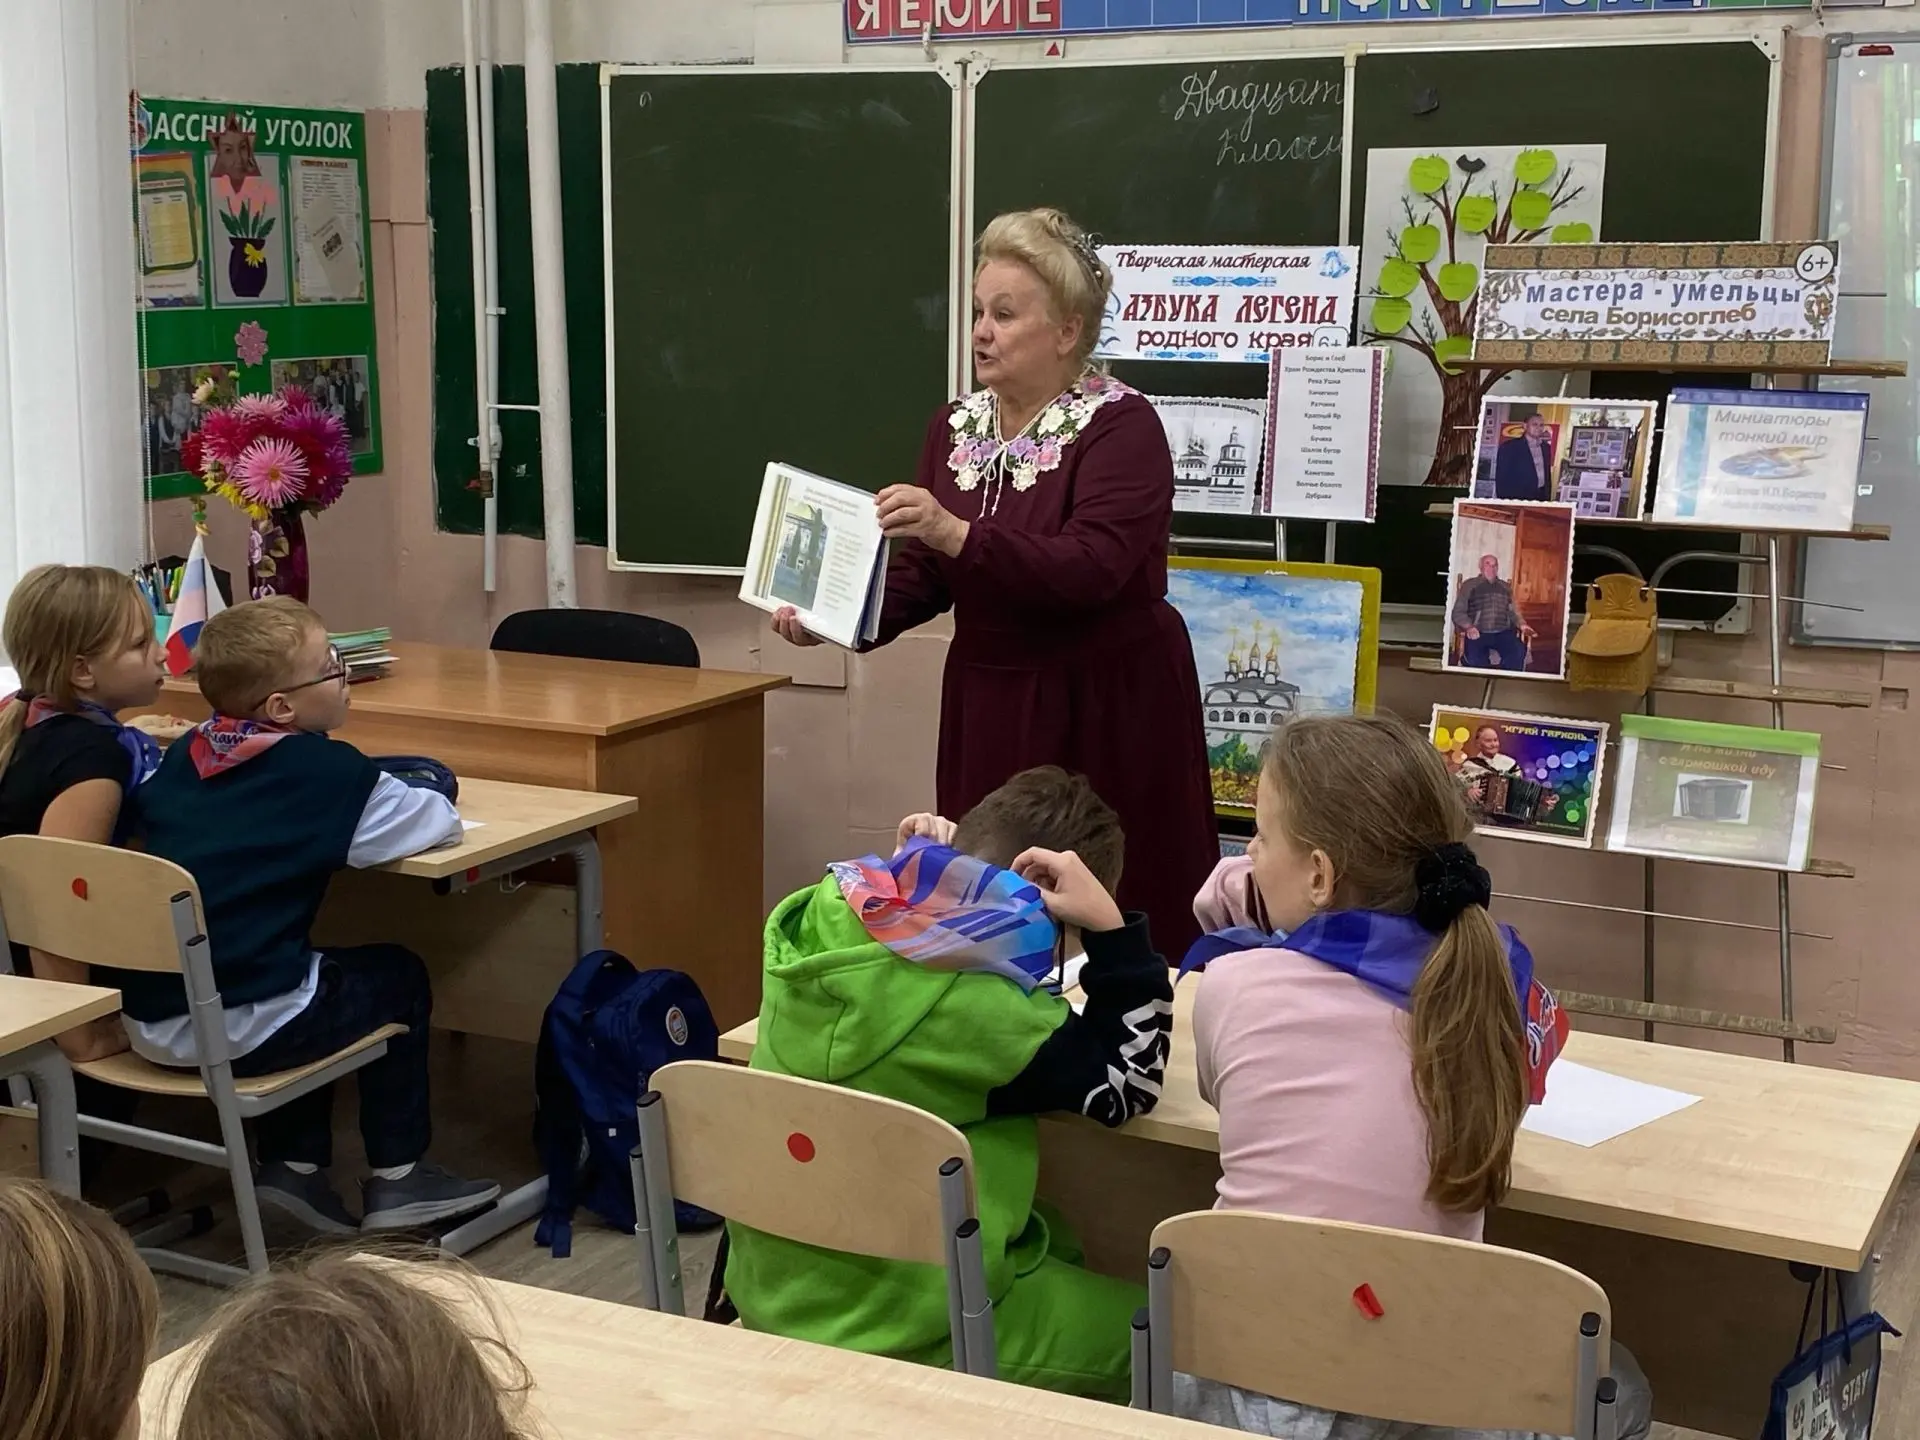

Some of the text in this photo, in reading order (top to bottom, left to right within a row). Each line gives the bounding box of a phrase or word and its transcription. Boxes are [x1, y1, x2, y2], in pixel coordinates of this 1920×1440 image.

[265, 118, 353, 150] УГОЛОК
[1116, 249, 1311, 273] Творческая мастерская
[1801, 253, 1830, 274] 6+
[1672, 280, 1801, 307] умельцы
[1122, 293, 1339, 325] АЗБУКА ЛЕГЕНД
[1539, 302, 1757, 330] села Борисоглеб
[1136, 329, 1313, 352] родного края
[1302, 366, 1336, 374] Рождества
[1221, 402, 1260, 416] монастырь
[1714, 410, 1832, 428] Миниатюры
[1718, 430, 1829, 448] тонкий мир
[1750, 767, 1777, 778] иду
